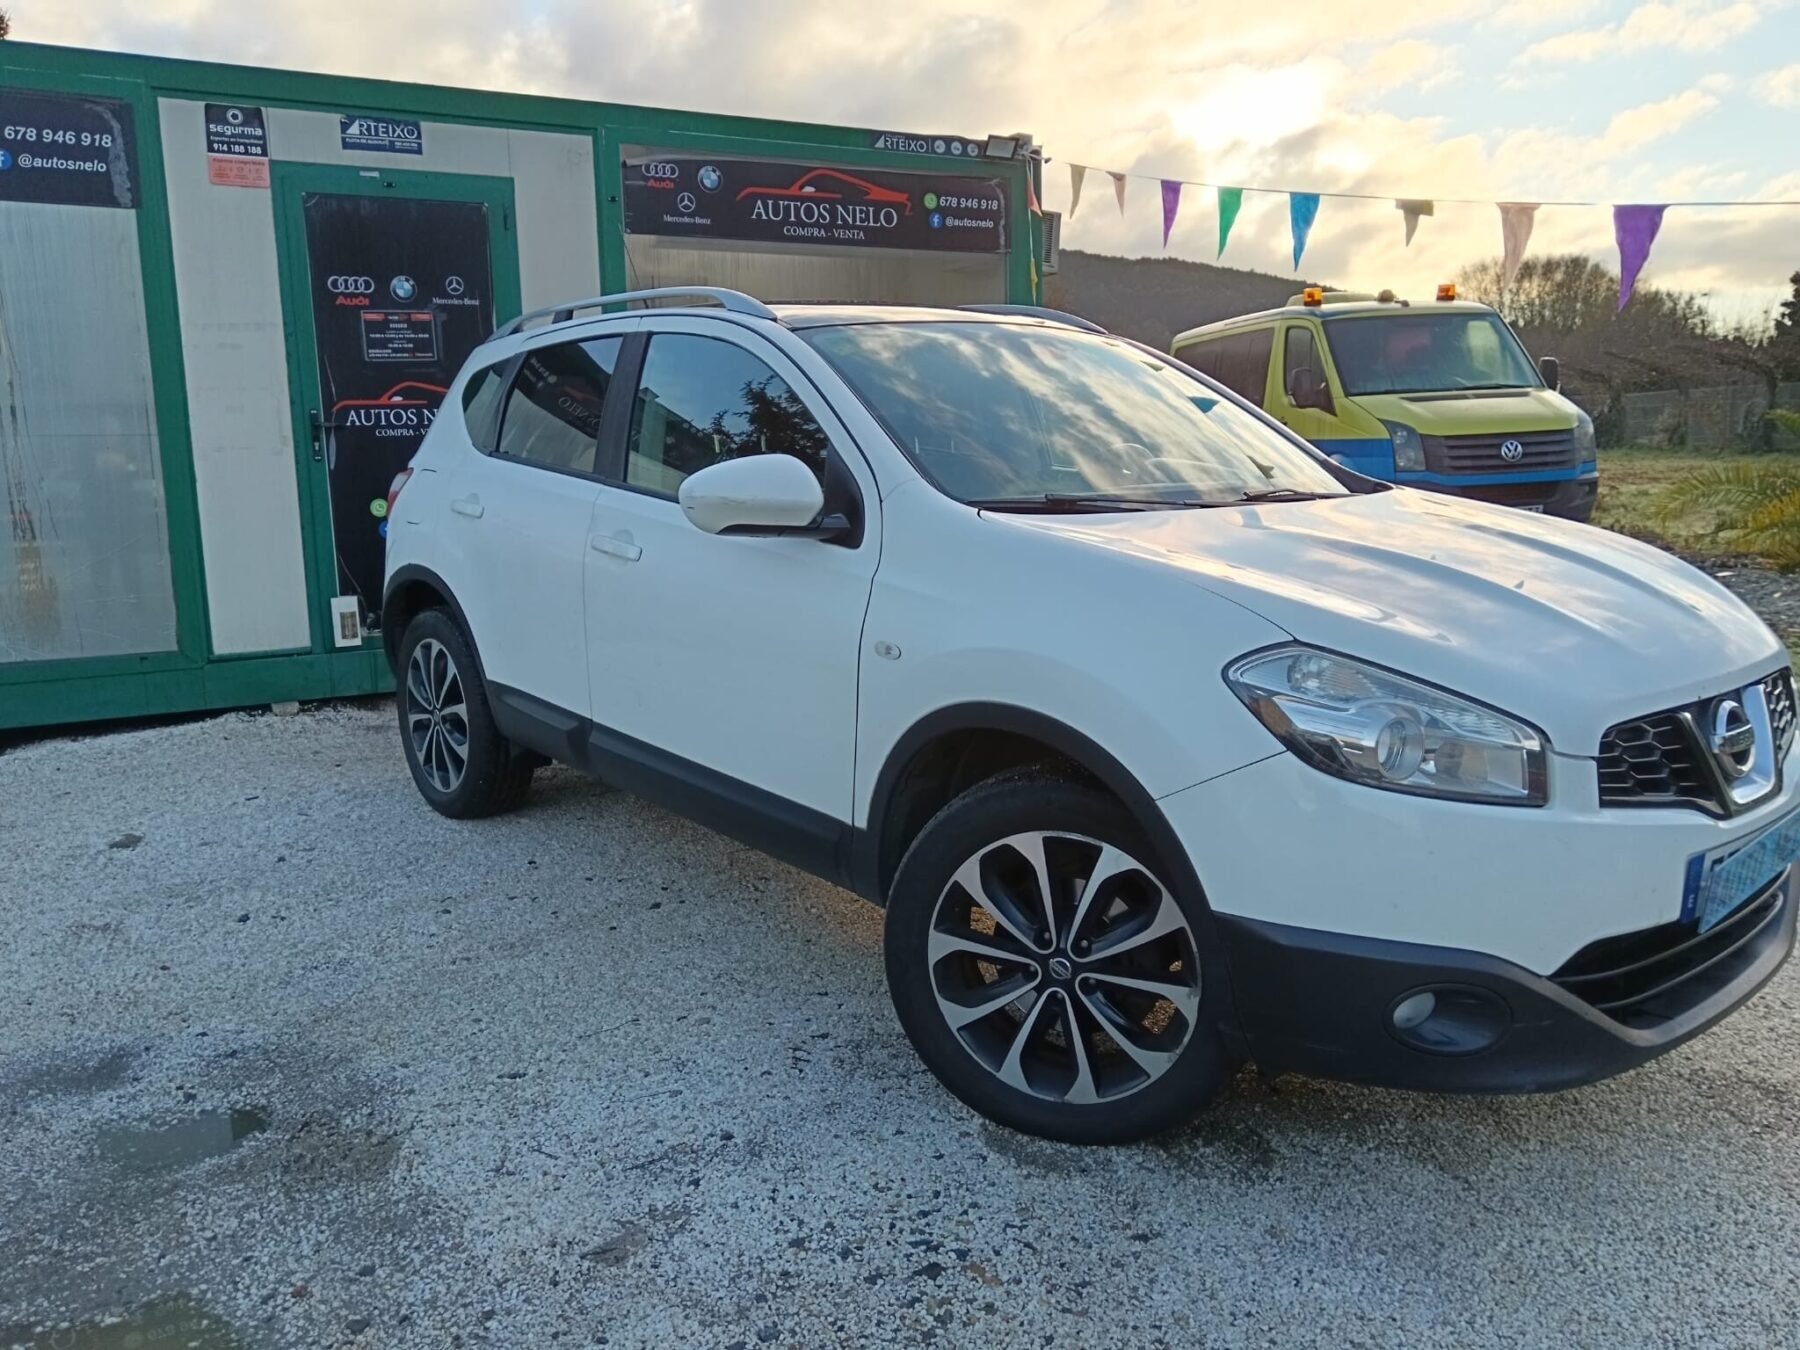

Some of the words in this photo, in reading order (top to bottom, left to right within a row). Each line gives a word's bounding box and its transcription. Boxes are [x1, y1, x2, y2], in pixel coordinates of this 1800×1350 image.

[4, 126, 37, 141] 678
[42, 128, 76, 144] 946
[80, 131, 112, 147] 918
[209, 124, 263, 136] segurma
[213, 143, 228, 151] 914
[230, 144, 245, 153] 188
[247, 146, 262, 154] 188
[18, 153, 107, 172] @autosnelo
[647, 179, 675, 188] Audi
[939, 196, 958, 207] 678
[959, 198, 979, 209] 946
[980, 199, 999, 210] 918
[751, 199, 830, 223] AUTOS
[836, 204, 898, 228] NELO
[945, 217, 994, 228] @autosnelo
[783, 225, 826, 238] COMPRA
[833, 229, 865, 240] VENTA
[336, 295, 370, 306] Audi
[346, 409, 417, 427] AUTOS
[375, 428, 414, 437] COMPRA
